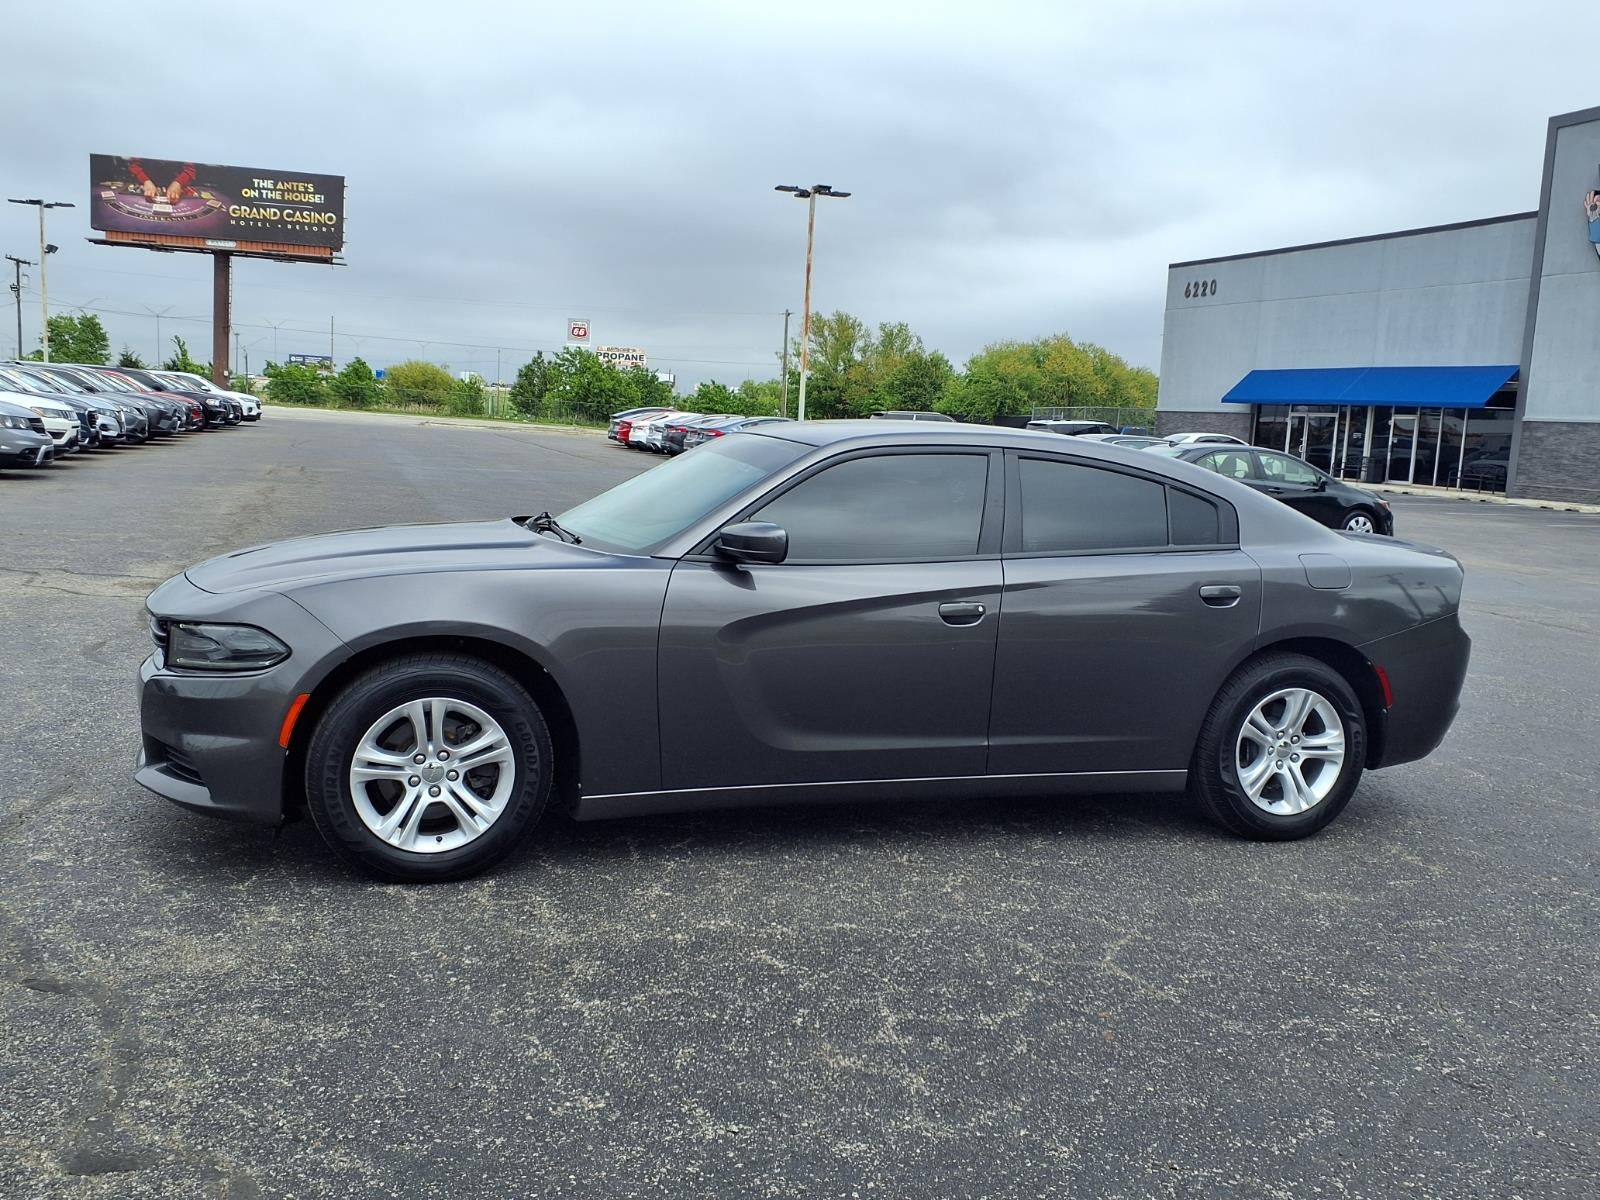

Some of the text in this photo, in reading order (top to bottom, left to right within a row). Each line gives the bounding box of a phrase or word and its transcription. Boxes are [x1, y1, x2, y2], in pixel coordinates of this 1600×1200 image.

[253, 178, 314, 192] THE ANTE'S
[241, 188, 325, 203] ON THE HOUSE!
[229, 204, 337, 225] GRAND CASINO
[230, 219, 335, 232] HOTEL RESORT
[1184, 279, 1217, 299] 6220
[573, 327, 585, 336] 66
[596, 351, 645, 361] PROPANE
